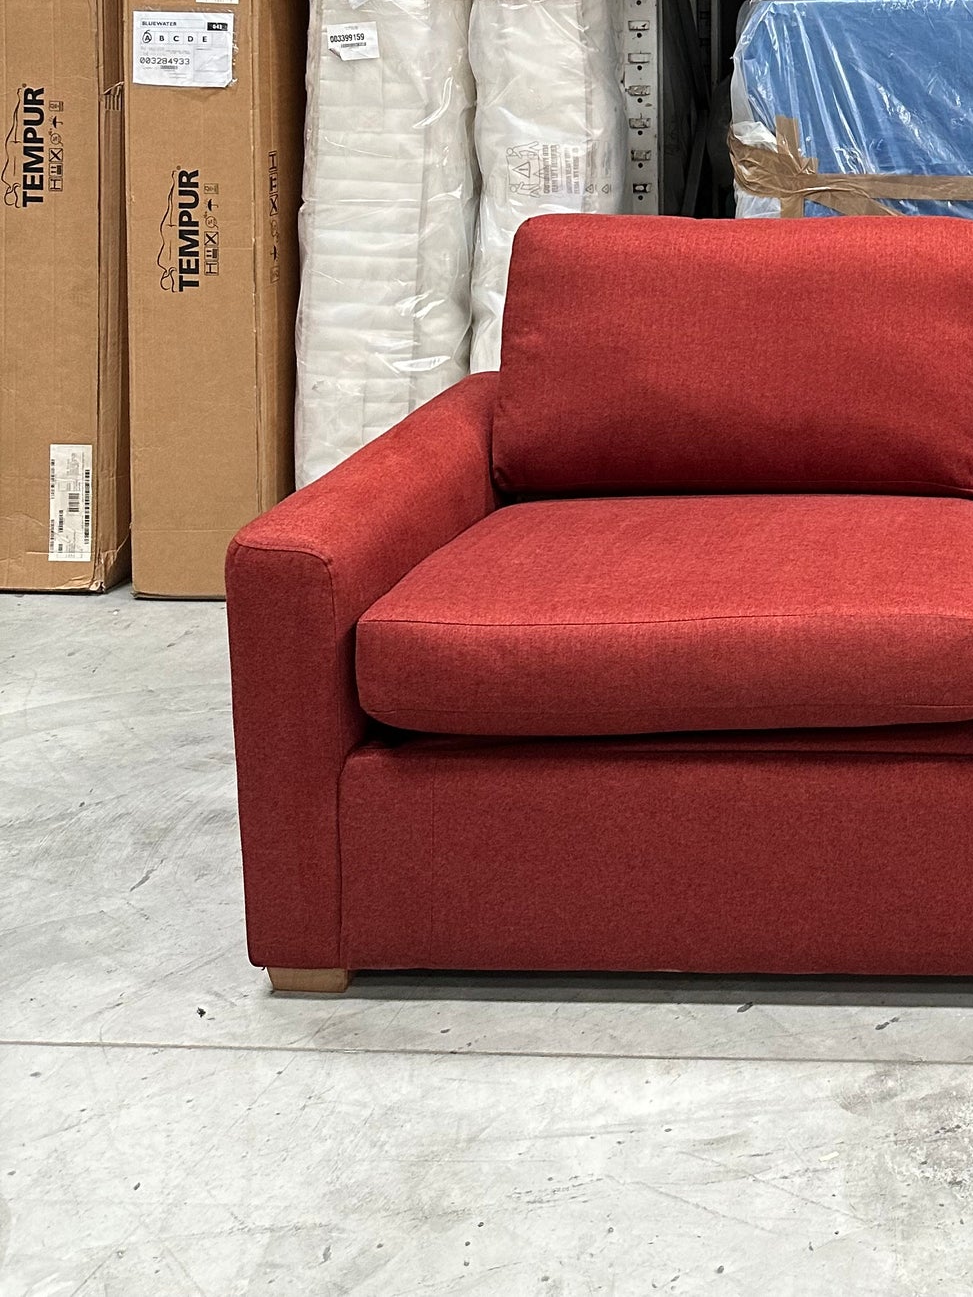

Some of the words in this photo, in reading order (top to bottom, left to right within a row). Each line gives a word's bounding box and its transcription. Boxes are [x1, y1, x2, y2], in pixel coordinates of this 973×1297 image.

[140, 56, 190, 65] 003284933
[23, 88, 44, 207] TEMPUR
[179, 170, 200, 292] TEMPUR
